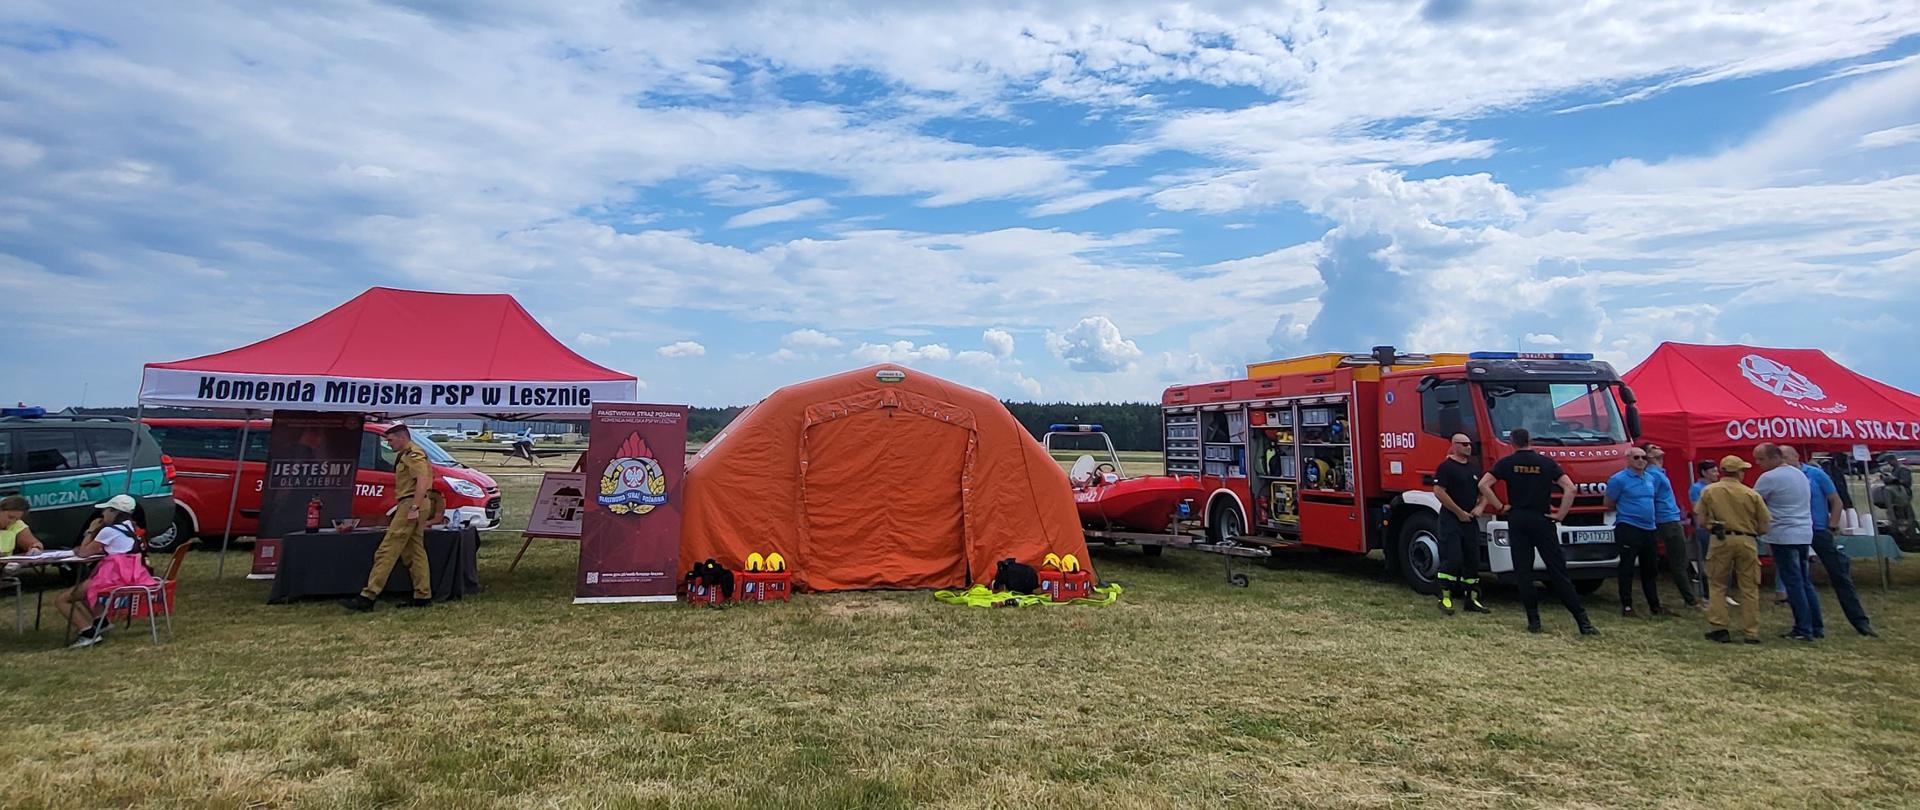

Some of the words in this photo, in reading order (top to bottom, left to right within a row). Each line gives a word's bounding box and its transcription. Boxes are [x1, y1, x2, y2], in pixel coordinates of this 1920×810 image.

[197, 376, 316, 402] Komenda
[323, 380, 423, 406] Miejska
[430, 384, 475, 405] PSP
[481, 387, 502, 406] w
[508, 385, 592, 406] Lesznie
[1725, 416, 1854, 440] OCHOTNICZA
[273, 461, 351, 476] JESTEŚMY
[280, 477, 301, 487] DLA
[306, 478, 342, 487] CIEBIE
[25, 489, 89, 506] ANICZNA
